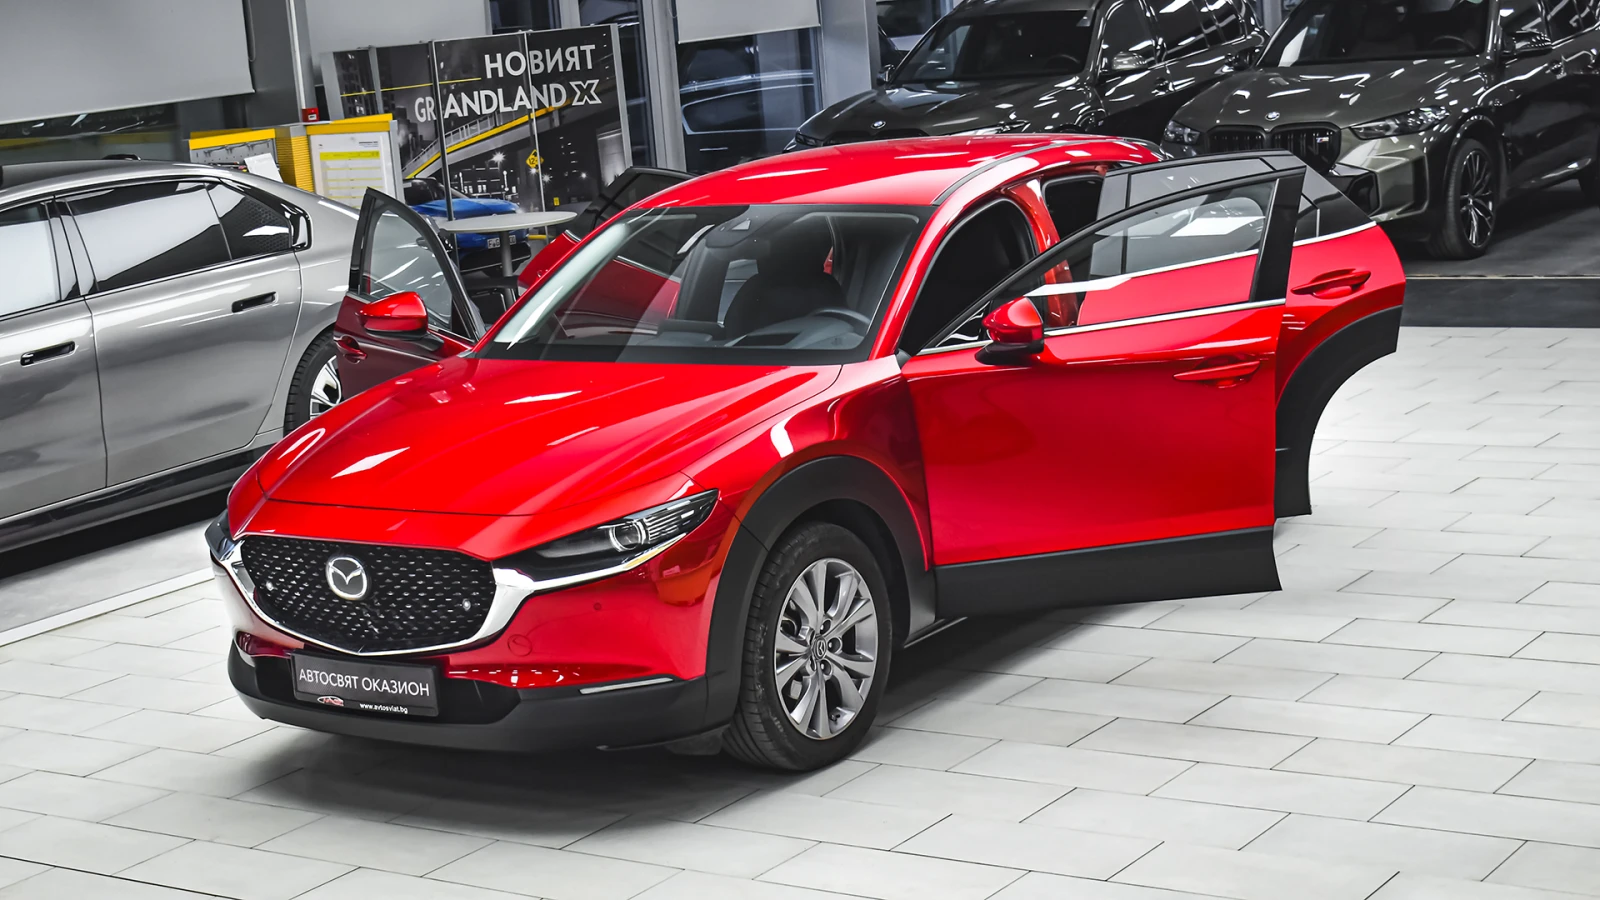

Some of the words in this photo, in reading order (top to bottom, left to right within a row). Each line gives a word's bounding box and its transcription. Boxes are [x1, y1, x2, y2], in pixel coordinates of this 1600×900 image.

[485, 44, 596, 79] НОВИЯТ
[414, 84, 567, 122] GRANDLAND
[569, 79, 602, 106] X
[299, 668, 359, 689] АВТОСВЯТ
[361, 676, 430, 696] ОКАЗИОН
[359, 703, 408, 714] www.avtosviat.bg
